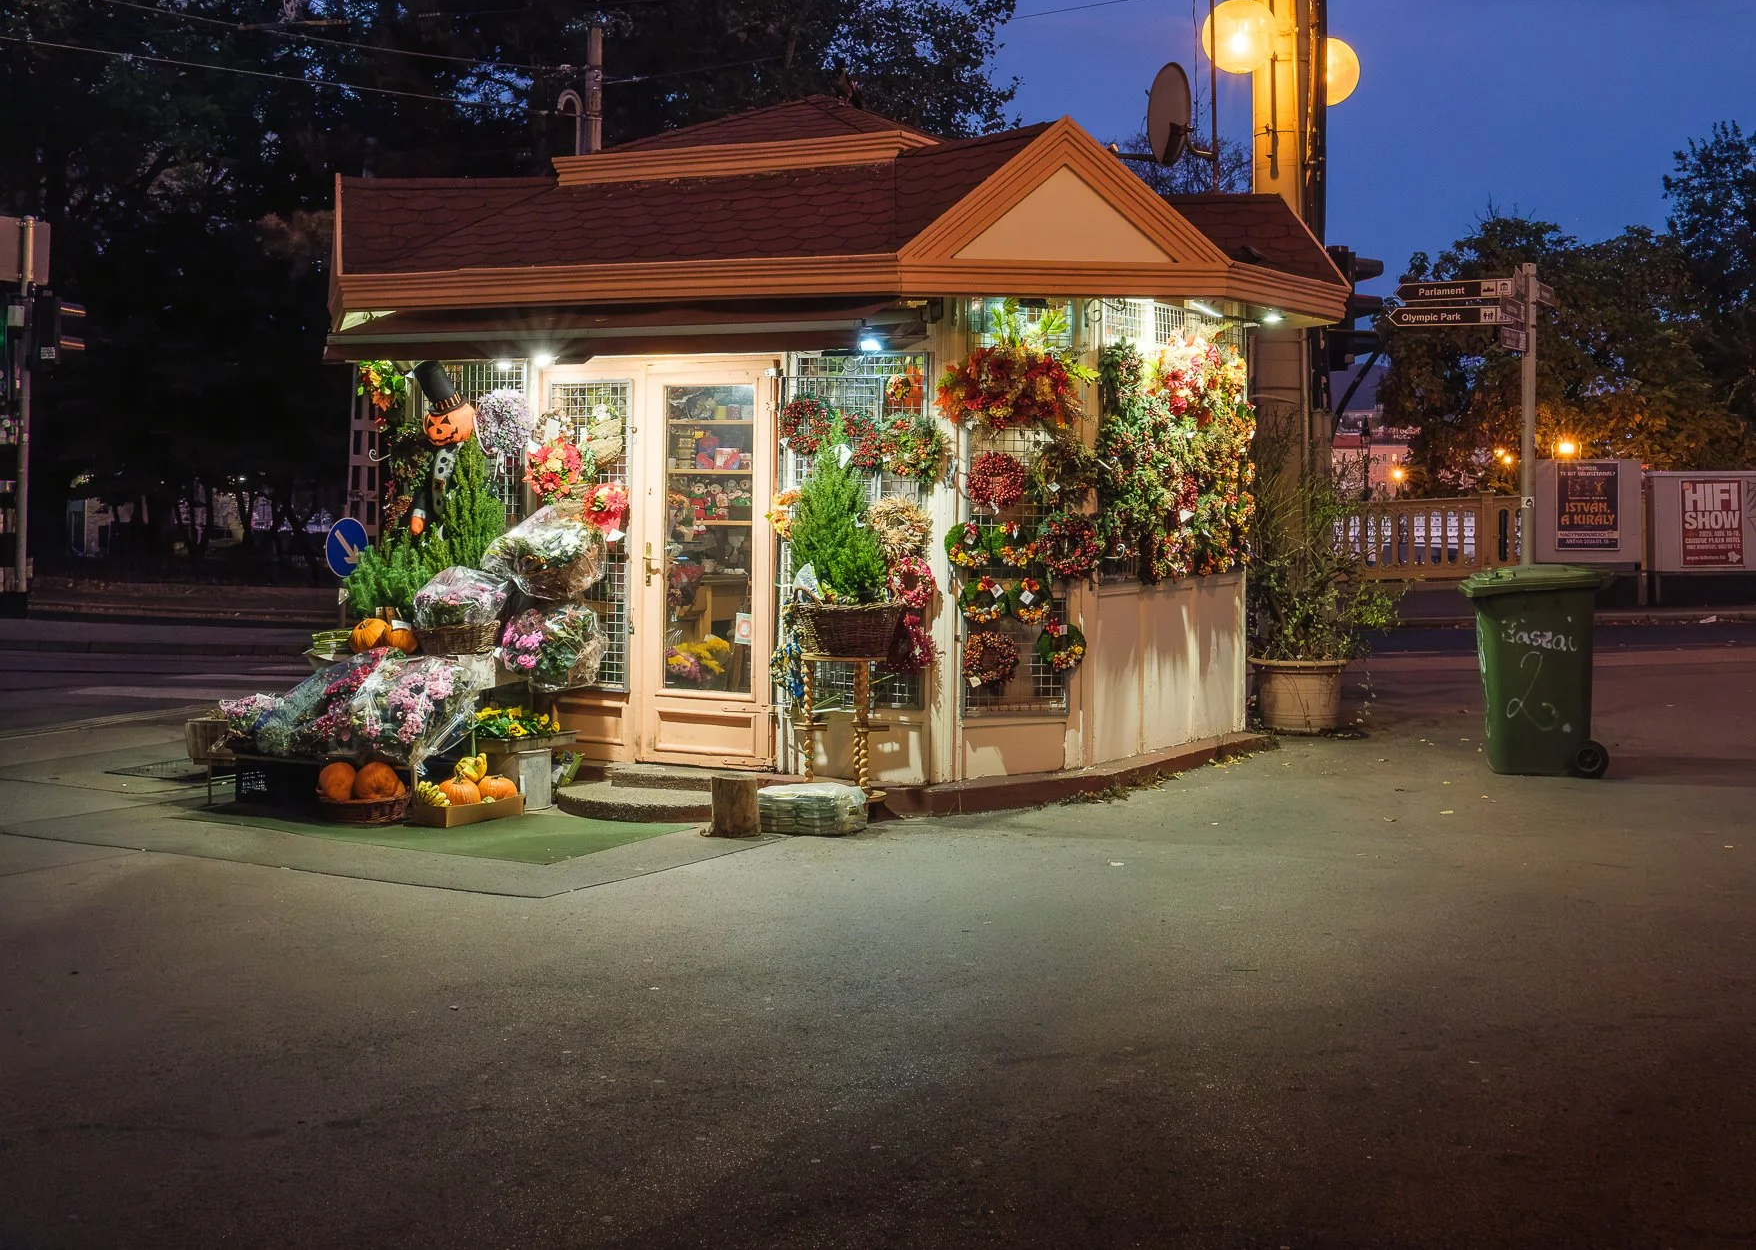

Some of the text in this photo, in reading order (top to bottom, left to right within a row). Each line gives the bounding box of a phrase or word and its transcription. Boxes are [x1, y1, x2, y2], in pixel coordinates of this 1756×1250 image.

[1401, 312, 1461, 323] Olympic Park
[1684, 482, 1739, 512] HIFI
[1566, 500, 1611, 513] ISTVÁN,
[1561, 513, 1616, 526] A KIRÁLY
[1684, 511, 1740, 530] SHOW
